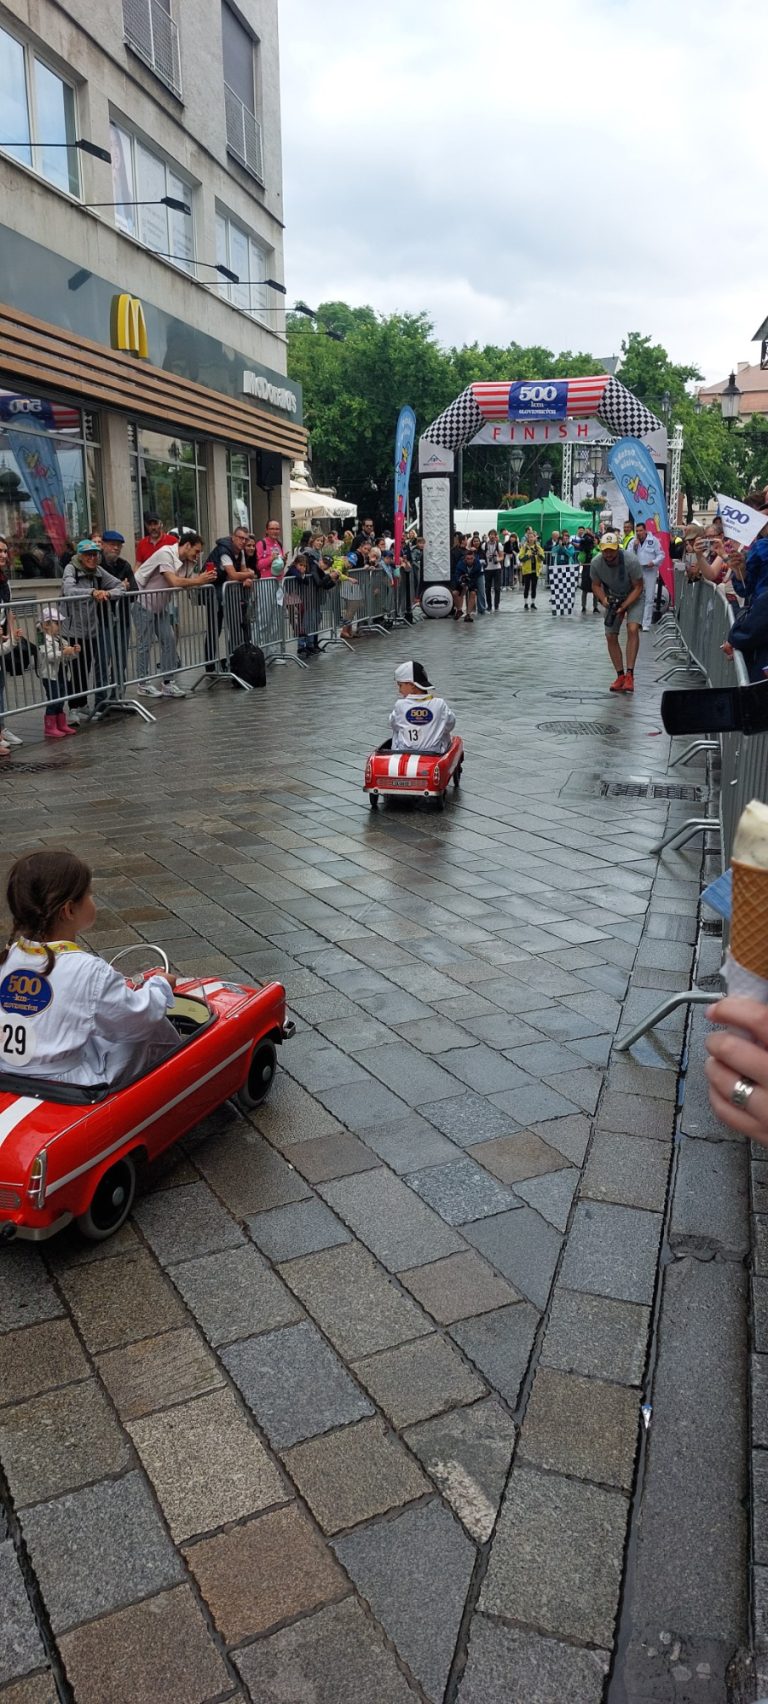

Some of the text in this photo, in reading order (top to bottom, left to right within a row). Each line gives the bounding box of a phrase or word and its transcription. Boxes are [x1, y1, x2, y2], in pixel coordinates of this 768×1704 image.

[519, 386, 558, 401] 500
[493, 424, 588, 440] FINISH
[721, 505, 750, 525] 500
[410, 709, 429, 717] 500
[408, 729, 419, 742] 13
[8, 975, 42, 996] 500
[3, 1024, 26, 1056] 29
